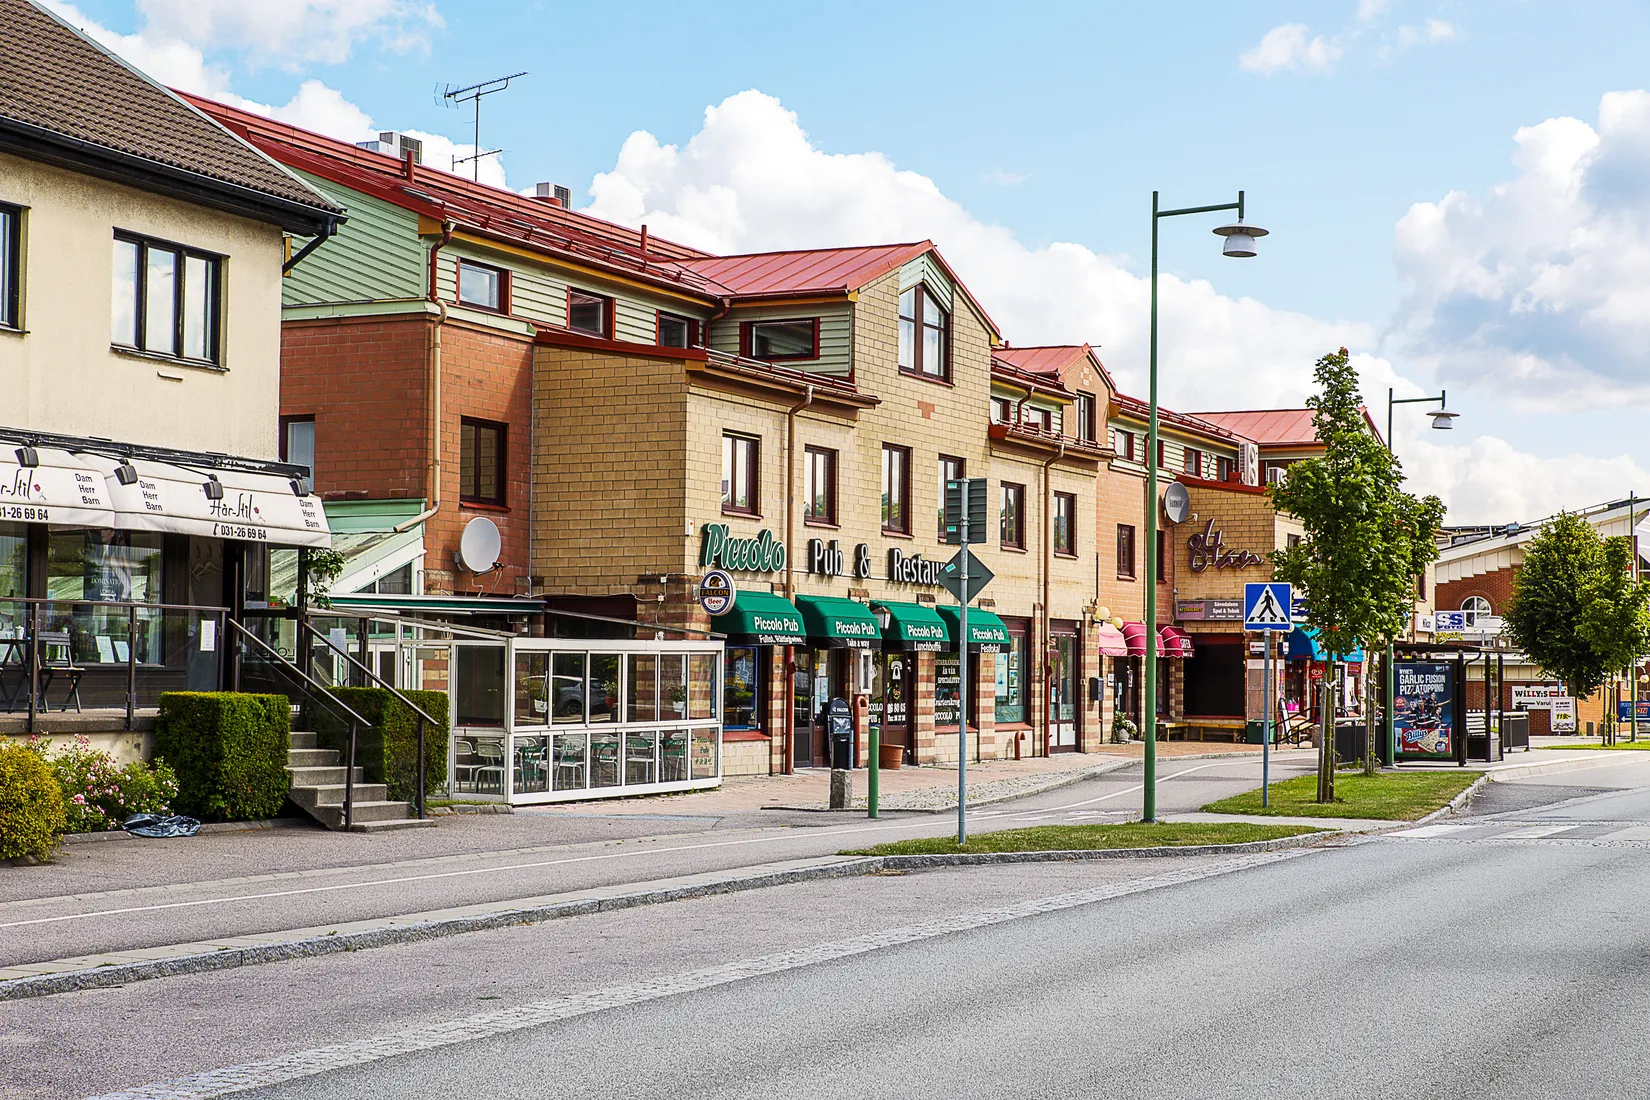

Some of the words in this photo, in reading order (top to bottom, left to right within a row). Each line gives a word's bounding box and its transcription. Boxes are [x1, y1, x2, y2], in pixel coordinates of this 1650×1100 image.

[75, 473, 93, 483] Dam
[79, 484, 95, 494] Herr
[140, 480, 156, 490] Dam
[82, 495, 101, 505] Barn
[143, 490, 159, 500] Herr
[145, 501, 163, 511] Barn
[300, 499, 314, 508] Dam
[25, 507, 35, 520] 69
[38, 508, 49, 521] 64
[303, 508, 316, 518] Herr
[305, 519, 321, 528] Barn
[221, 525, 246, 537] 031-26
[247, 527, 257, 538] 69
[258, 529, 267, 540] 64
[704, 522, 785, 573] Piccolo
[813, 537, 844, 576] Pub
[859, 543, 871, 578] &
[754, 616, 783, 631] Piccolo
[783, 618, 799, 632] Pub
[1437, 613, 1463, 625] SS
[835, 621, 861, 635] Piccolo
[861, 623, 875, 635] Pub
[907, 624, 930, 637] Piccolo
[930, 626, 944, 638] Pub
[972, 628, 993, 640] Piccolo
[993, 629, 1005, 640] Pub
[845, 638, 857, 647] Take
[860, 640, 870, 648] way
[914, 641, 942, 652] Lunchbuffé
[1400, 674, 1424, 684] GARLIC
[1425, 674, 1446, 684] FUSION
